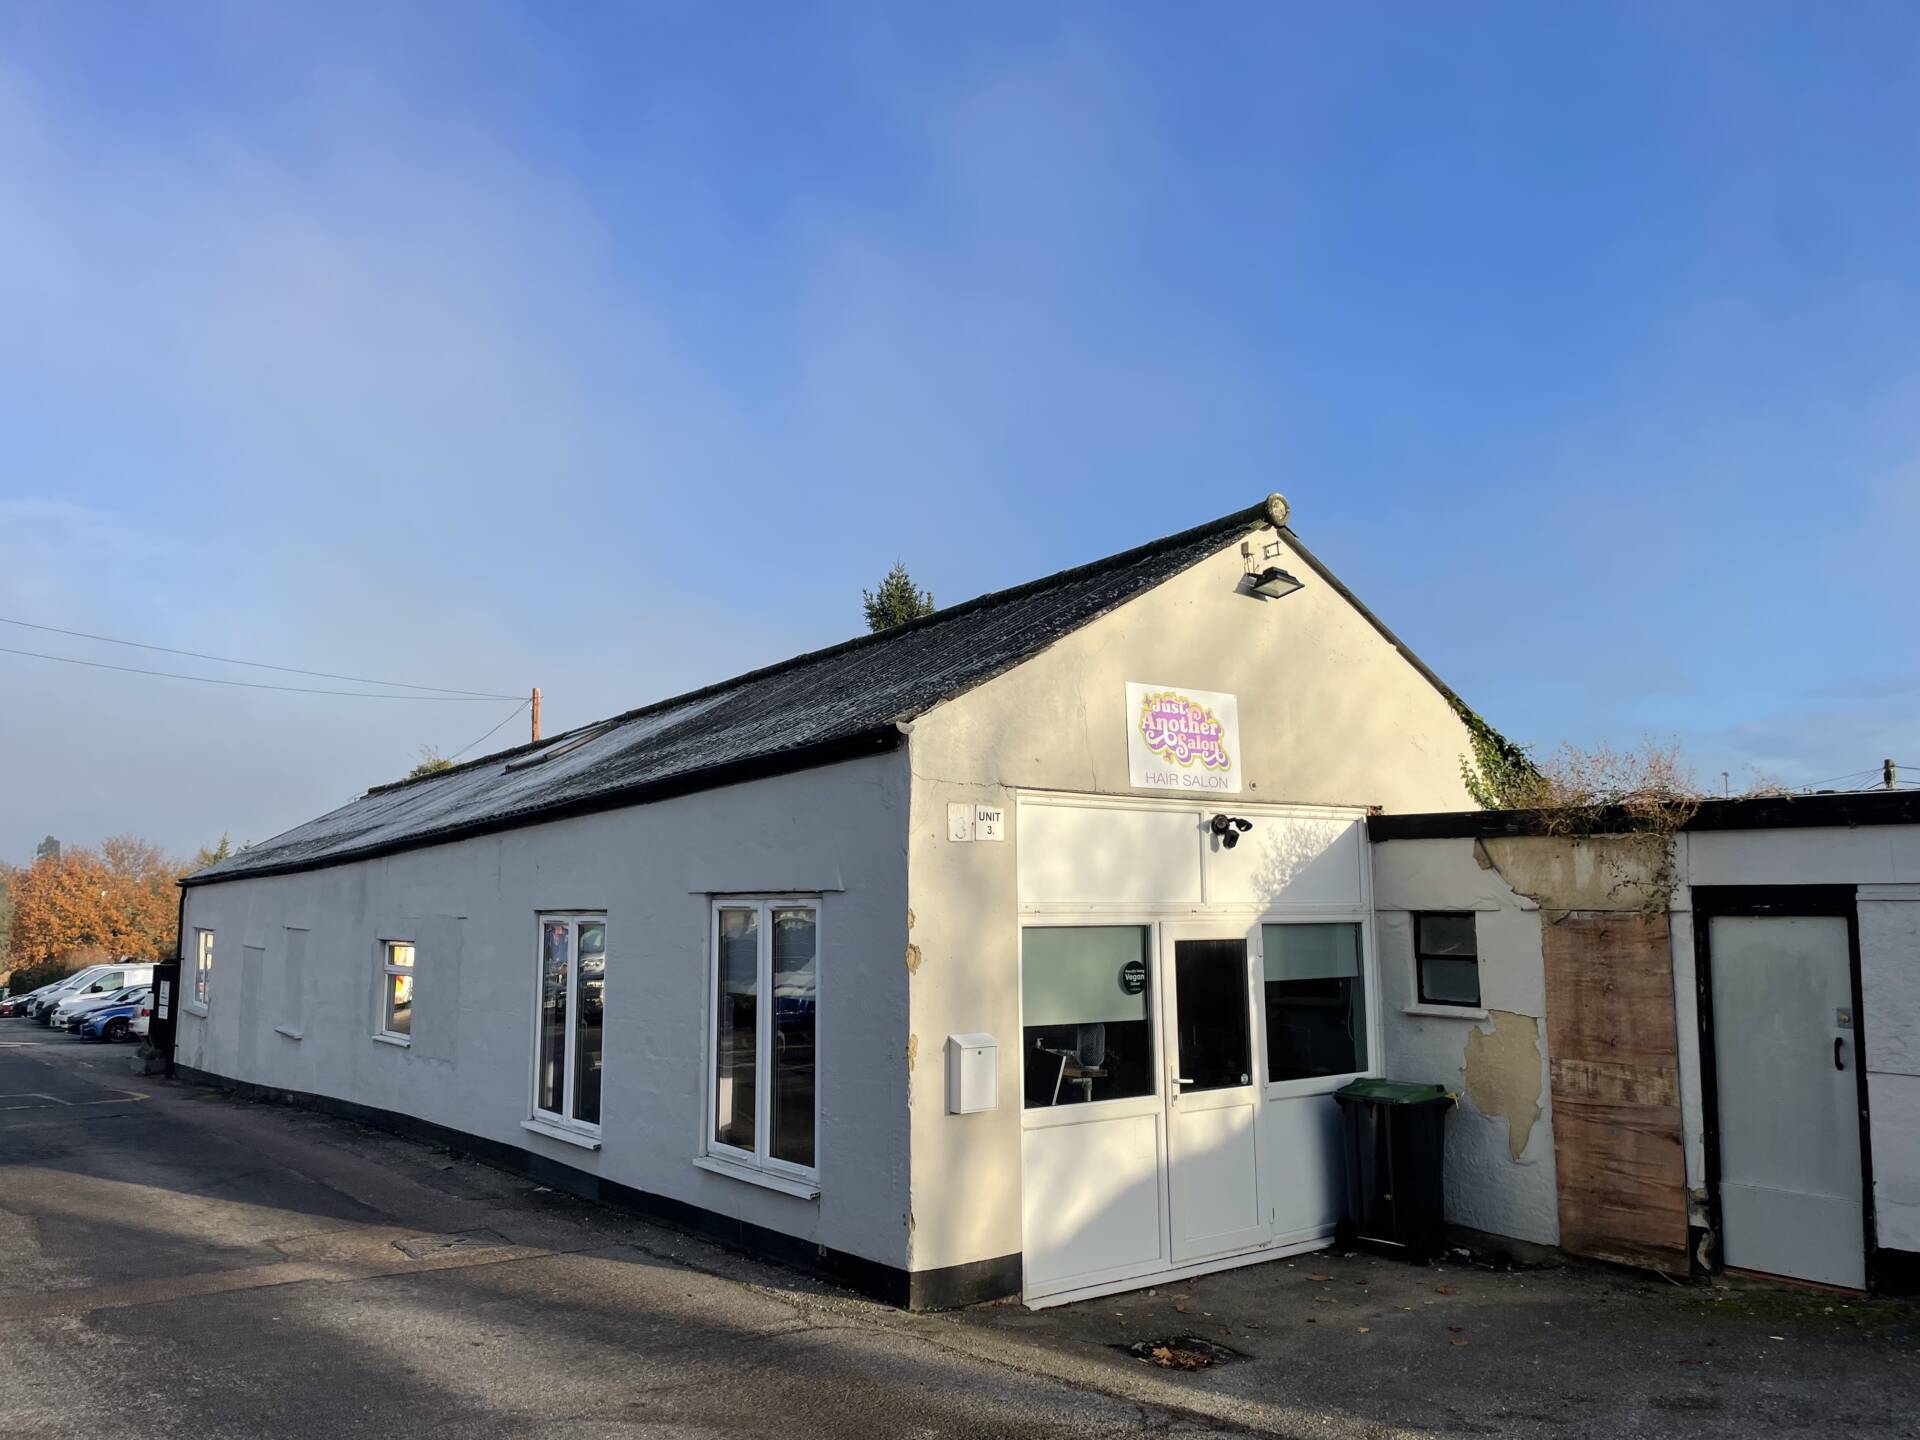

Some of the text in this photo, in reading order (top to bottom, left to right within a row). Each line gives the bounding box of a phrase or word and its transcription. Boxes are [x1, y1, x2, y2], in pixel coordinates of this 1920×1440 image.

[1152, 698, 1188, 715] Just
[1142, 704, 1222, 746] Another
[1176, 736, 1226, 763] Salon
[1145, 772, 1228, 788] HAIR SALON
[978, 811, 1001, 822] UNIT
